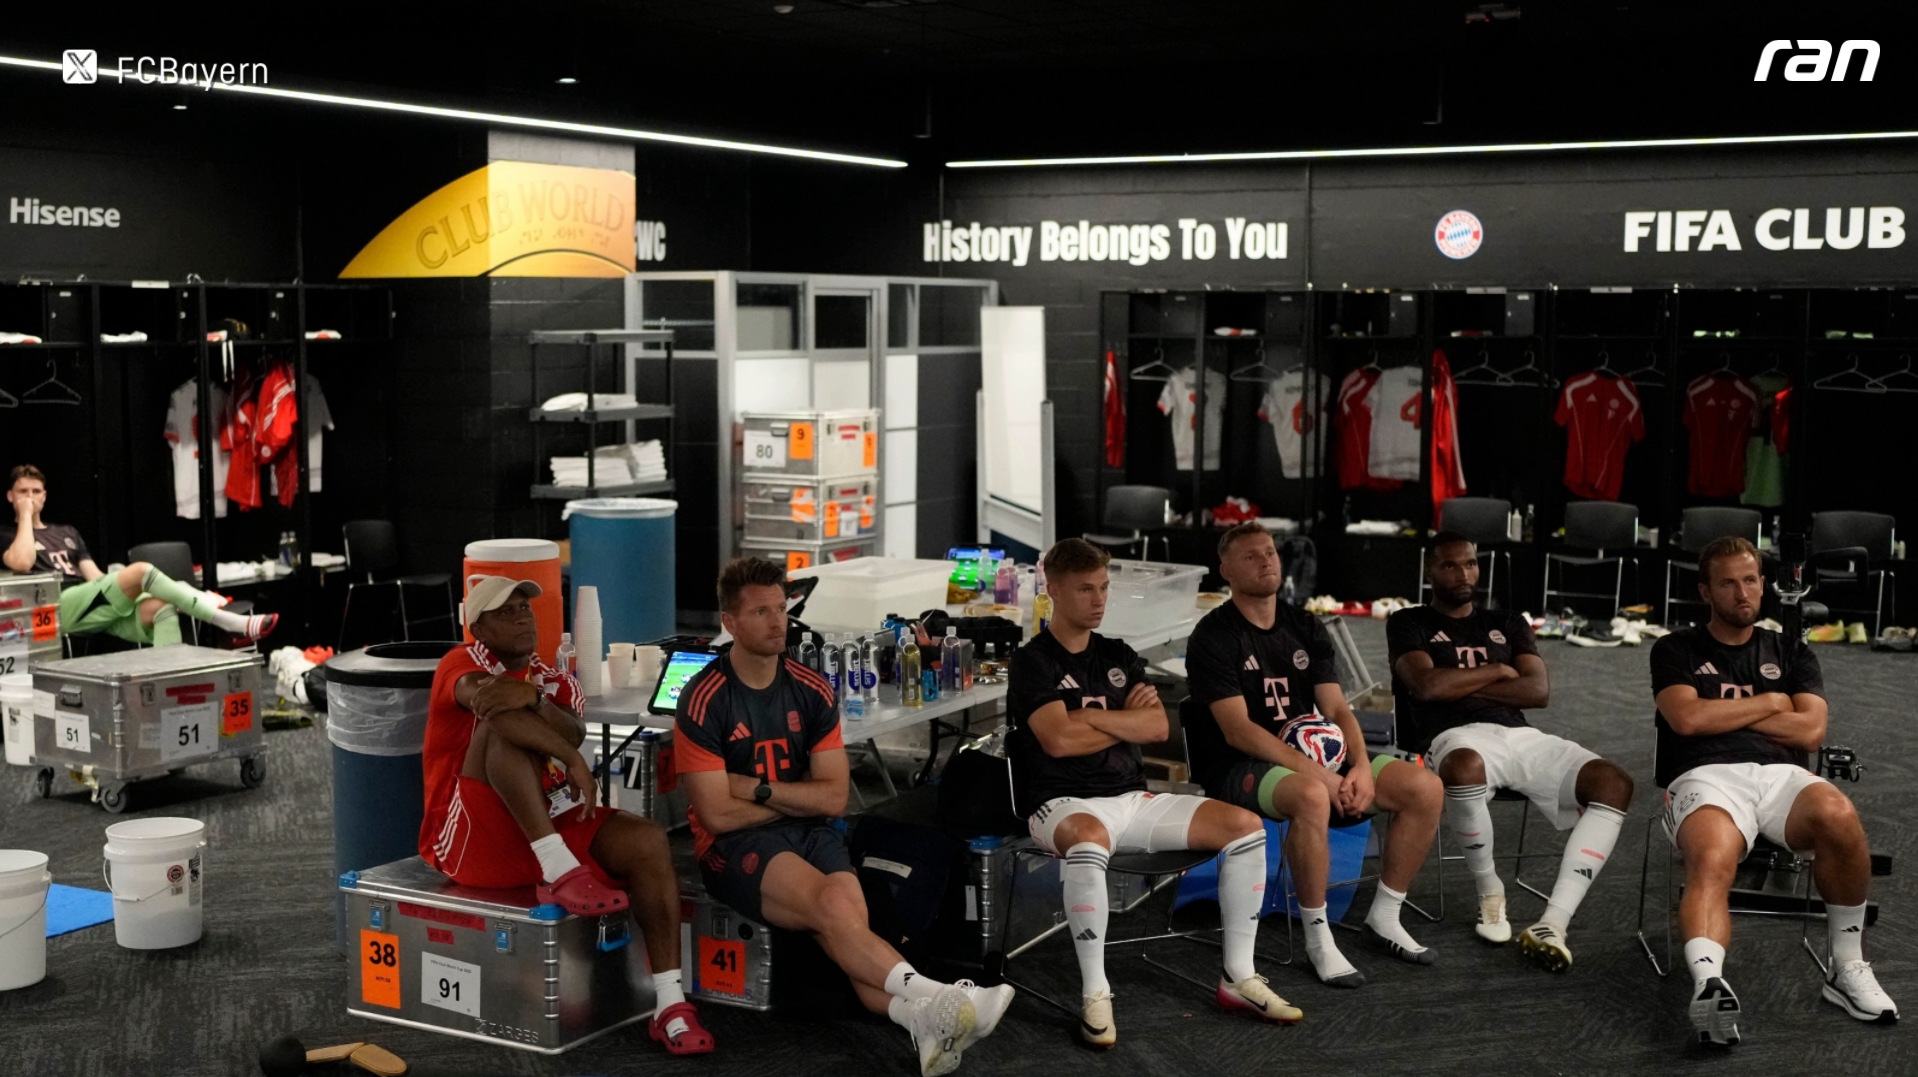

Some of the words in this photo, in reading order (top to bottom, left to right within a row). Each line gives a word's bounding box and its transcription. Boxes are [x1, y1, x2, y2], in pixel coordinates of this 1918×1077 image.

[10, 196, 121, 228] Hisense
[415, 191, 513, 270] CLUB
[517, 180, 625, 232] WORLD
[1624, 209, 1742, 253] FIFA
[1755, 206, 1906, 250] CLUB
[634, 220, 666, 262] WC
[923, 219, 1033, 267] History
[1040, 219, 1171, 266] Belongs
[1179, 218, 1217, 260] To
[1225, 217, 1289, 260] You
[797, 428, 805, 441] 9
[756, 444, 773, 459] 80
[35, 612, 51, 627] 36
[230, 699, 249, 717] 35
[1263, 676, 1290, 721] T
[66, 727, 79, 742] 51
[178, 723, 199, 746] 51
[625, 749, 642, 789] 7
[369, 940, 397, 968] 38
[710, 948, 736, 973] 41
[439, 977, 460, 1001] 91
[488, 1022, 539, 1044] ZARGES
